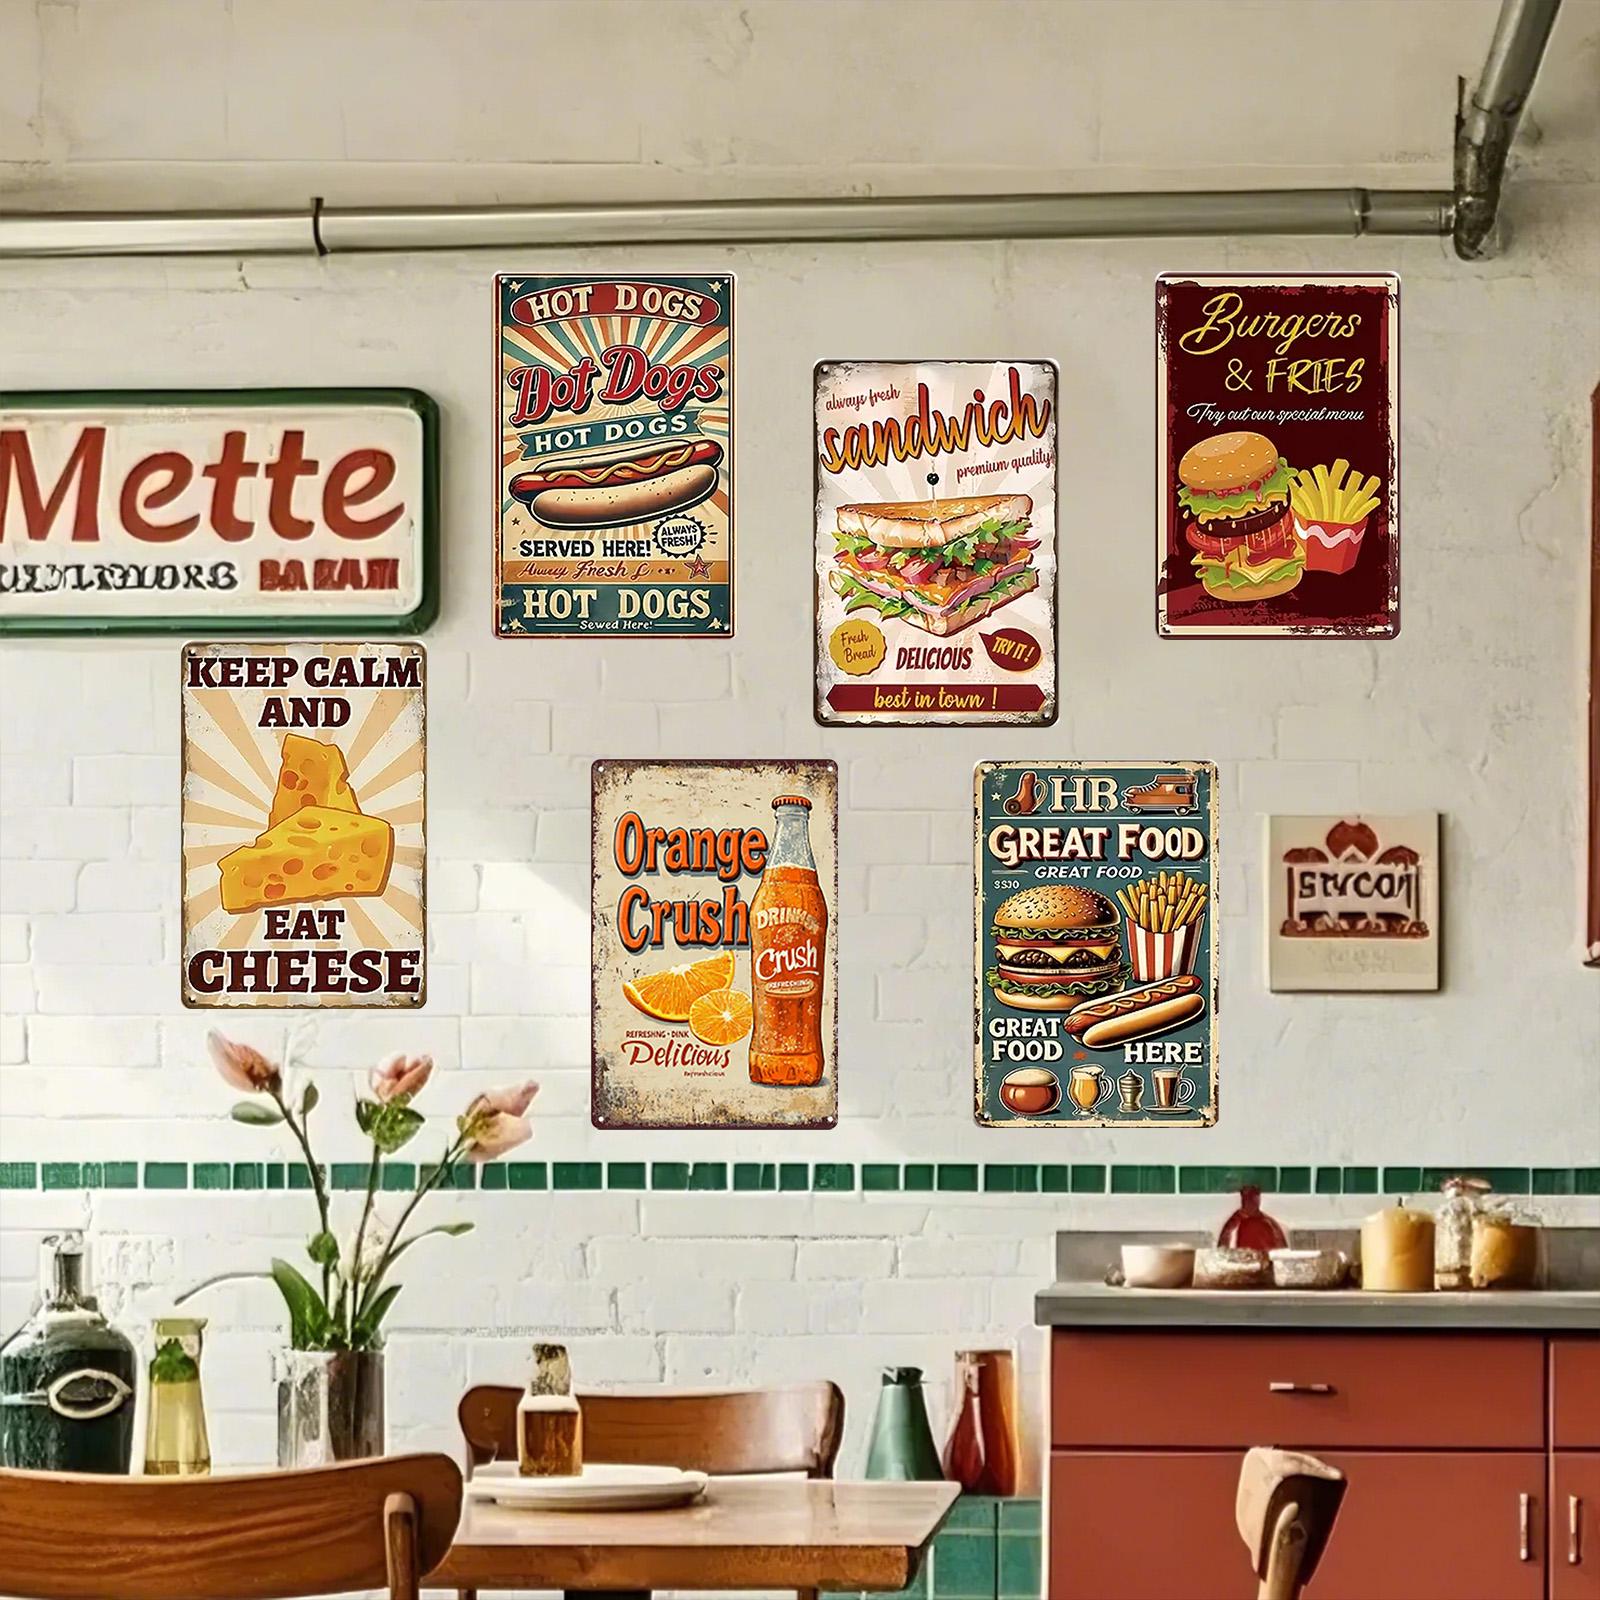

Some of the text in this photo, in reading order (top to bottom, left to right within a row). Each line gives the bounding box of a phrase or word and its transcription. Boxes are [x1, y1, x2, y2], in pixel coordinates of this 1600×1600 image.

[527, 284, 703, 321] HOT DOGS
[1179, 292, 1362, 355] Burgers
[599, 345, 724, 411] Dogs
[1225, 357, 1366, 395] & FRIES
[826, 384, 900, 411] always fresh
[820, 367, 1050, 474] sandwich
[1186, 402, 1365, 427] Try out our special menu
[534, 414, 688, 453] HOT DOGS
[957, 448, 1051, 484] premium quality
[0, 426, 405, 544] Mette
[661, 525, 697, 536] ALWAYS
[661, 535, 697, 547] FRESH!
[520, 540, 651, 557] SERVED HERE!
[572, 560, 628, 580] Fresh
[523, 589, 710, 619] HOT DOGS
[840, 630, 869, 647] Fresh
[992, 636, 1016, 655] TRY
[1012, 642, 1027, 659] IT
[844, 645, 876, 663] Bread
[896, 647, 974, 671] DELICIOUS
[187, 657, 421, 688] KEEP CALM
[258, 697, 351, 727] AND
[874, 687, 912, 708] best
[914, 691, 936, 707] in
[938, 688, 985, 708] town
[614, 811, 768, 882] Orange
[988, 823, 1205, 867] GREAT FOOD
[1035, 866, 1143, 879] GREAT FOOD
[264, 910, 345, 940] EAT
[617, 885, 751, 954] Crush
[188, 951, 421, 993] CHEESE
[755, 938, 817, 980] Crush
[988, 1018, 1062, 1038] GREAT
[991, 1039, 1065, 1061] FOOD
[1123, 1042, 1203, 1064] HERE
